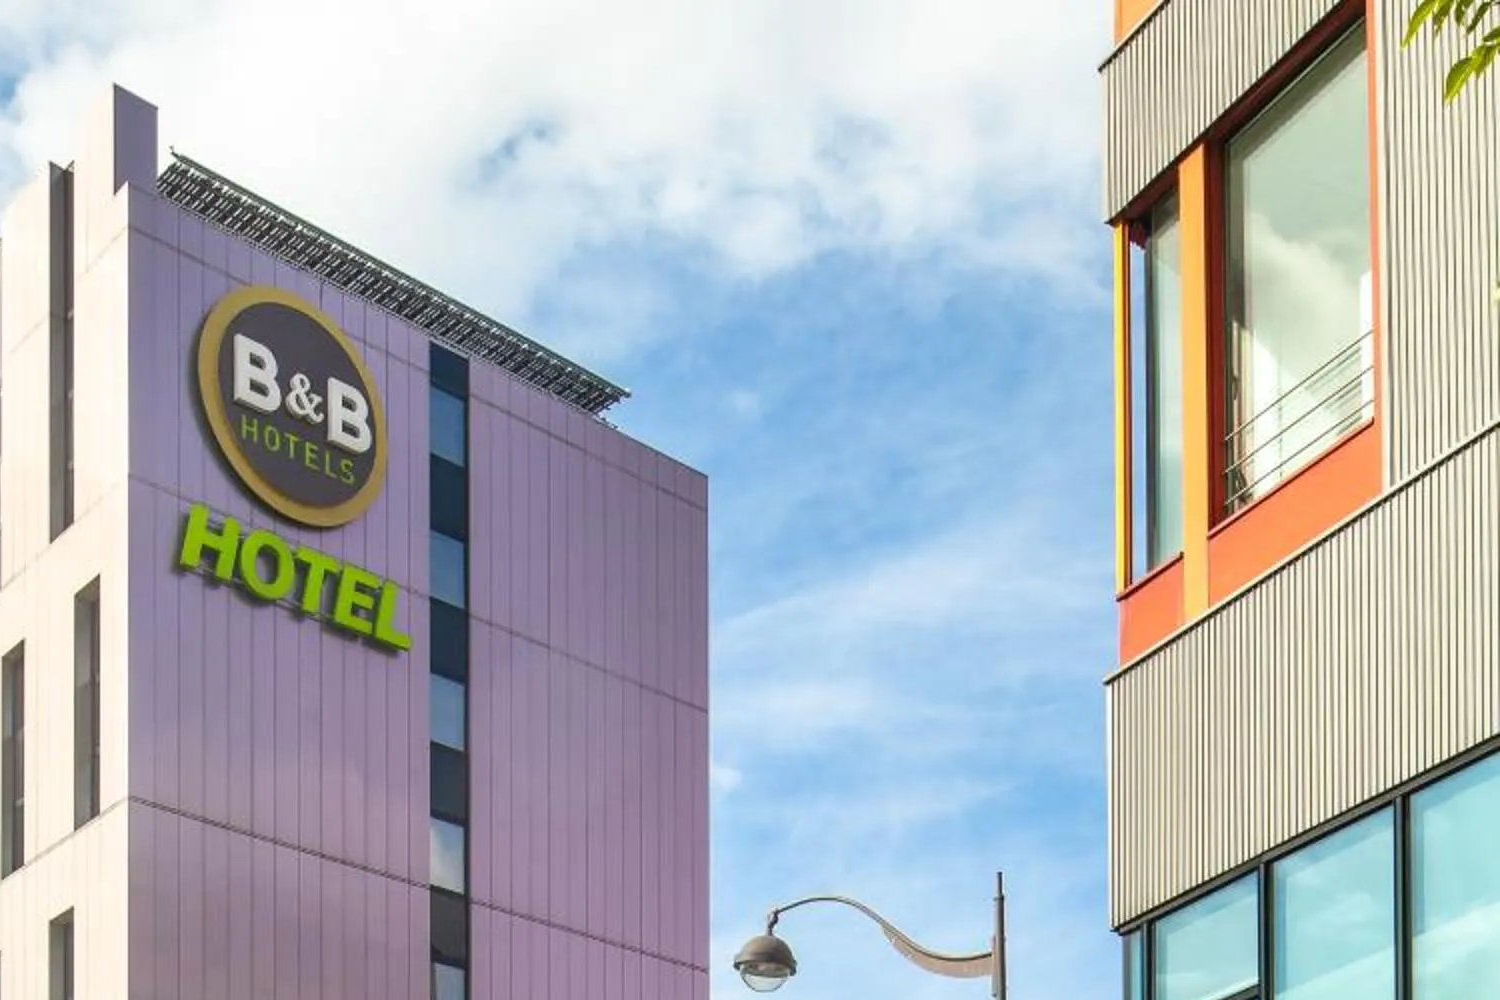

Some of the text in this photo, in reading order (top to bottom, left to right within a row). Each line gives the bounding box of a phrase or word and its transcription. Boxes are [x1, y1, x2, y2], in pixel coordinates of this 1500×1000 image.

[232, 333, 374, 455] B&B
[240, 413, 356, 486] HOTELS
[179, 503, 412, 652] HOTEL
